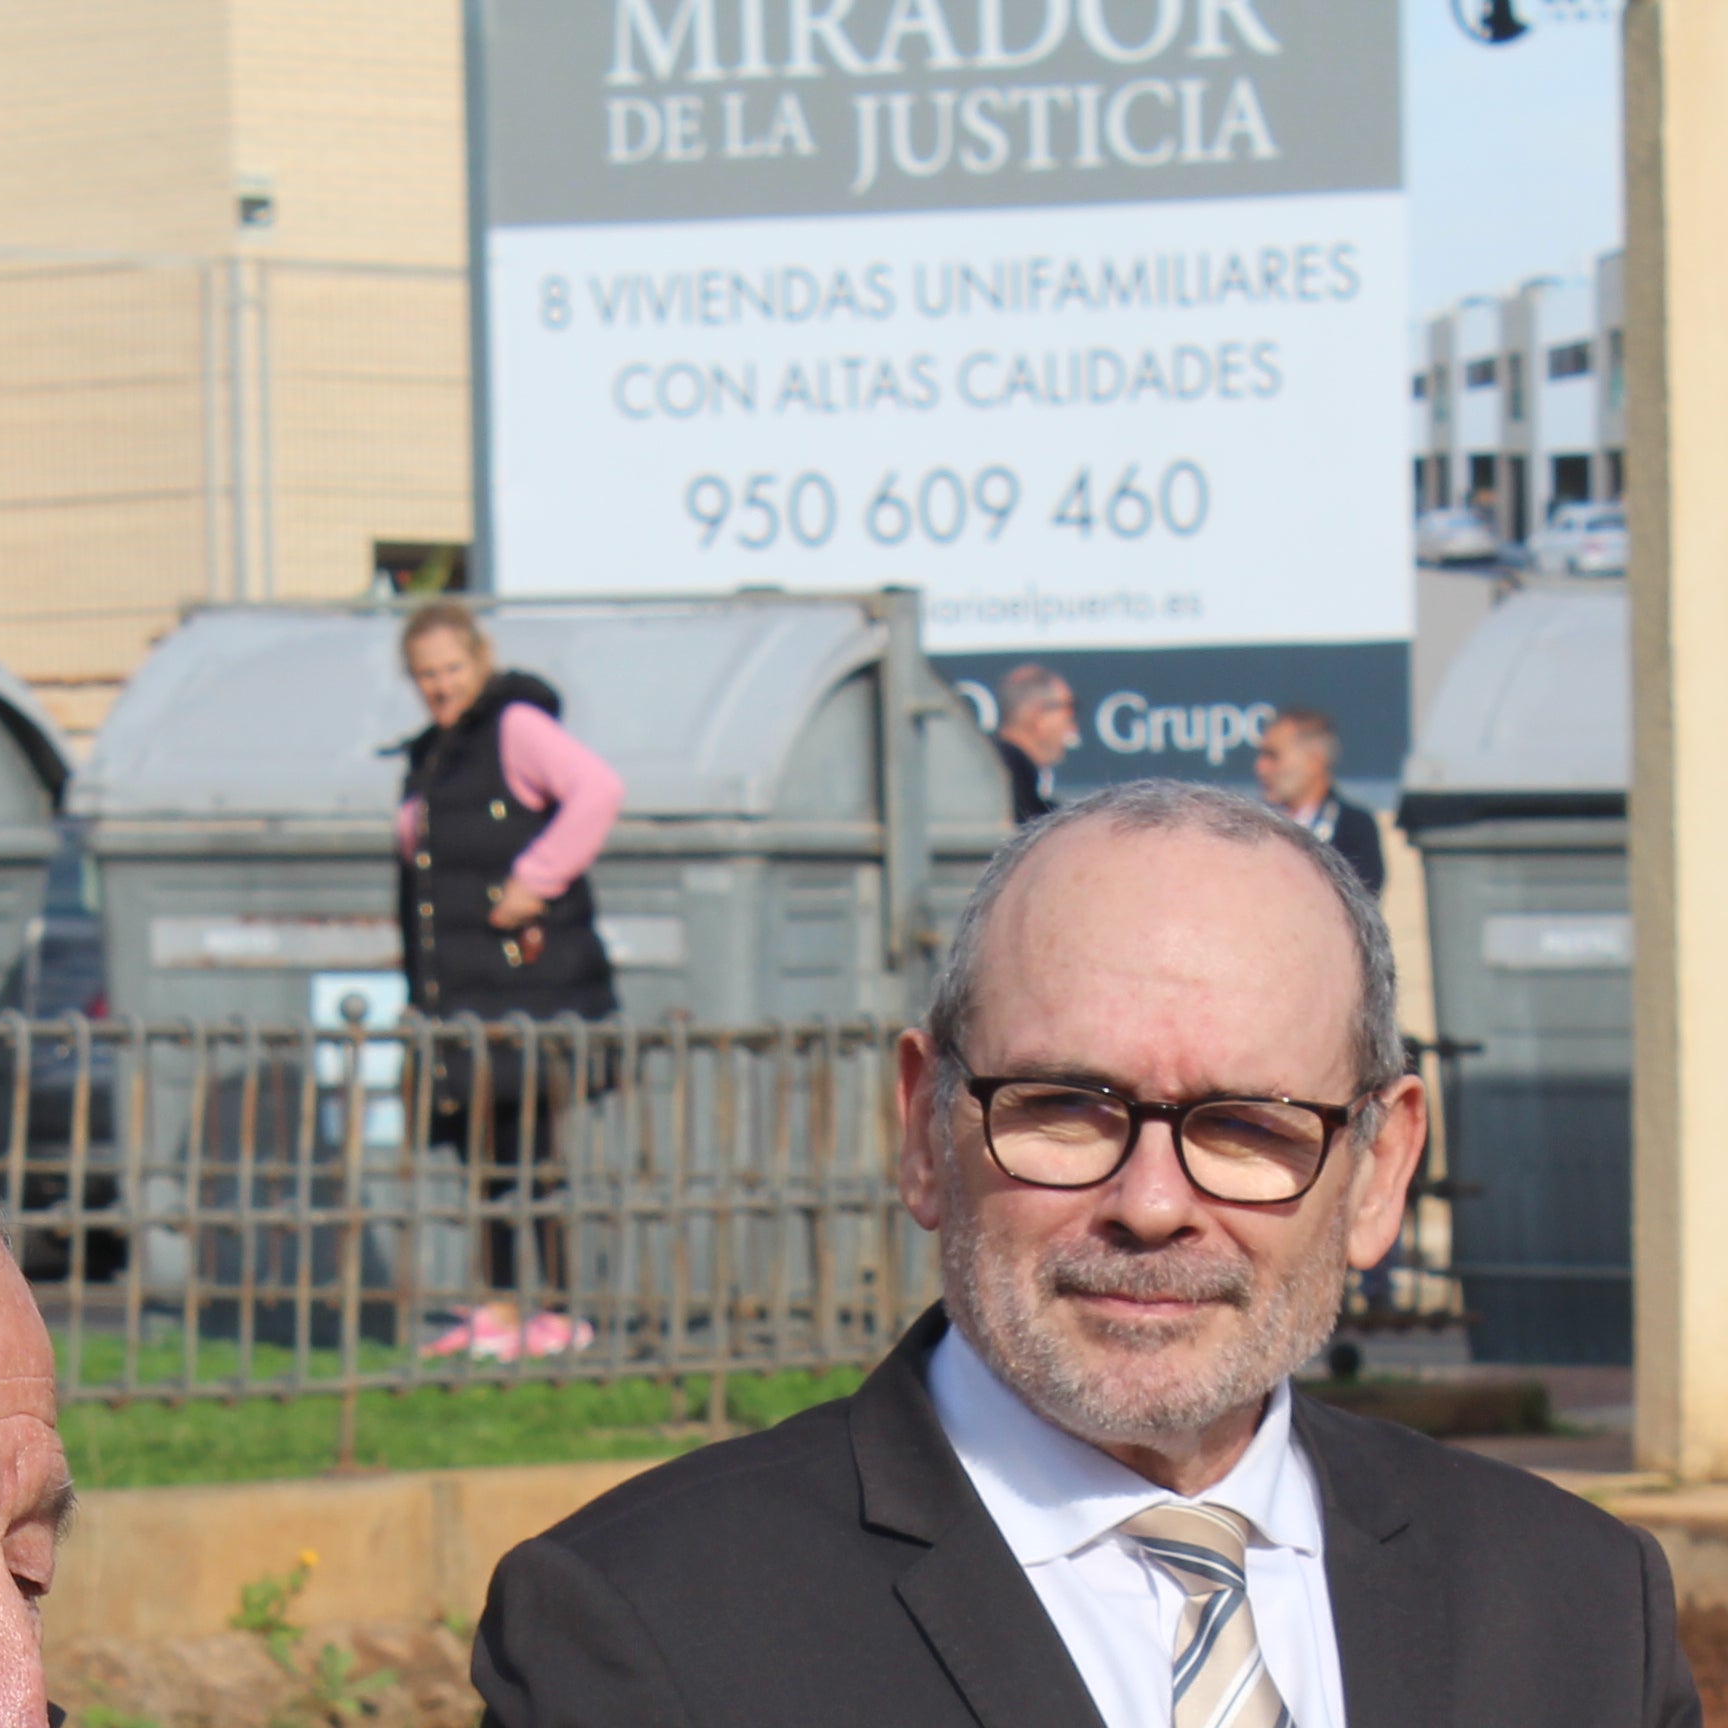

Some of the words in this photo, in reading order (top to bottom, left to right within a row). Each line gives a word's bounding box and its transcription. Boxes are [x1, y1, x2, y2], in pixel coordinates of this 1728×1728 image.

[606, 94, 706, 164] DE
[723, 92, 816, 158] LA
[850, 76, 1280, 196] JUSTICIA
[539, 272, 574, 331] 8
[586, 260, 898, 327] VIVIENDAS
[912, 242, 1362, 319] UNIFAMILIARES
[612, 362, 756, 421] CON
[773, 352, 943, 415] ALTAS
[955, 339, 1285, 410] CALIDADES
[683, 472, 838, 551] 950
[862, 464, 1023, 547] 609
[1051, 457, 1211, 542] 460
[1094, 690, 1277, 766] Grupo
